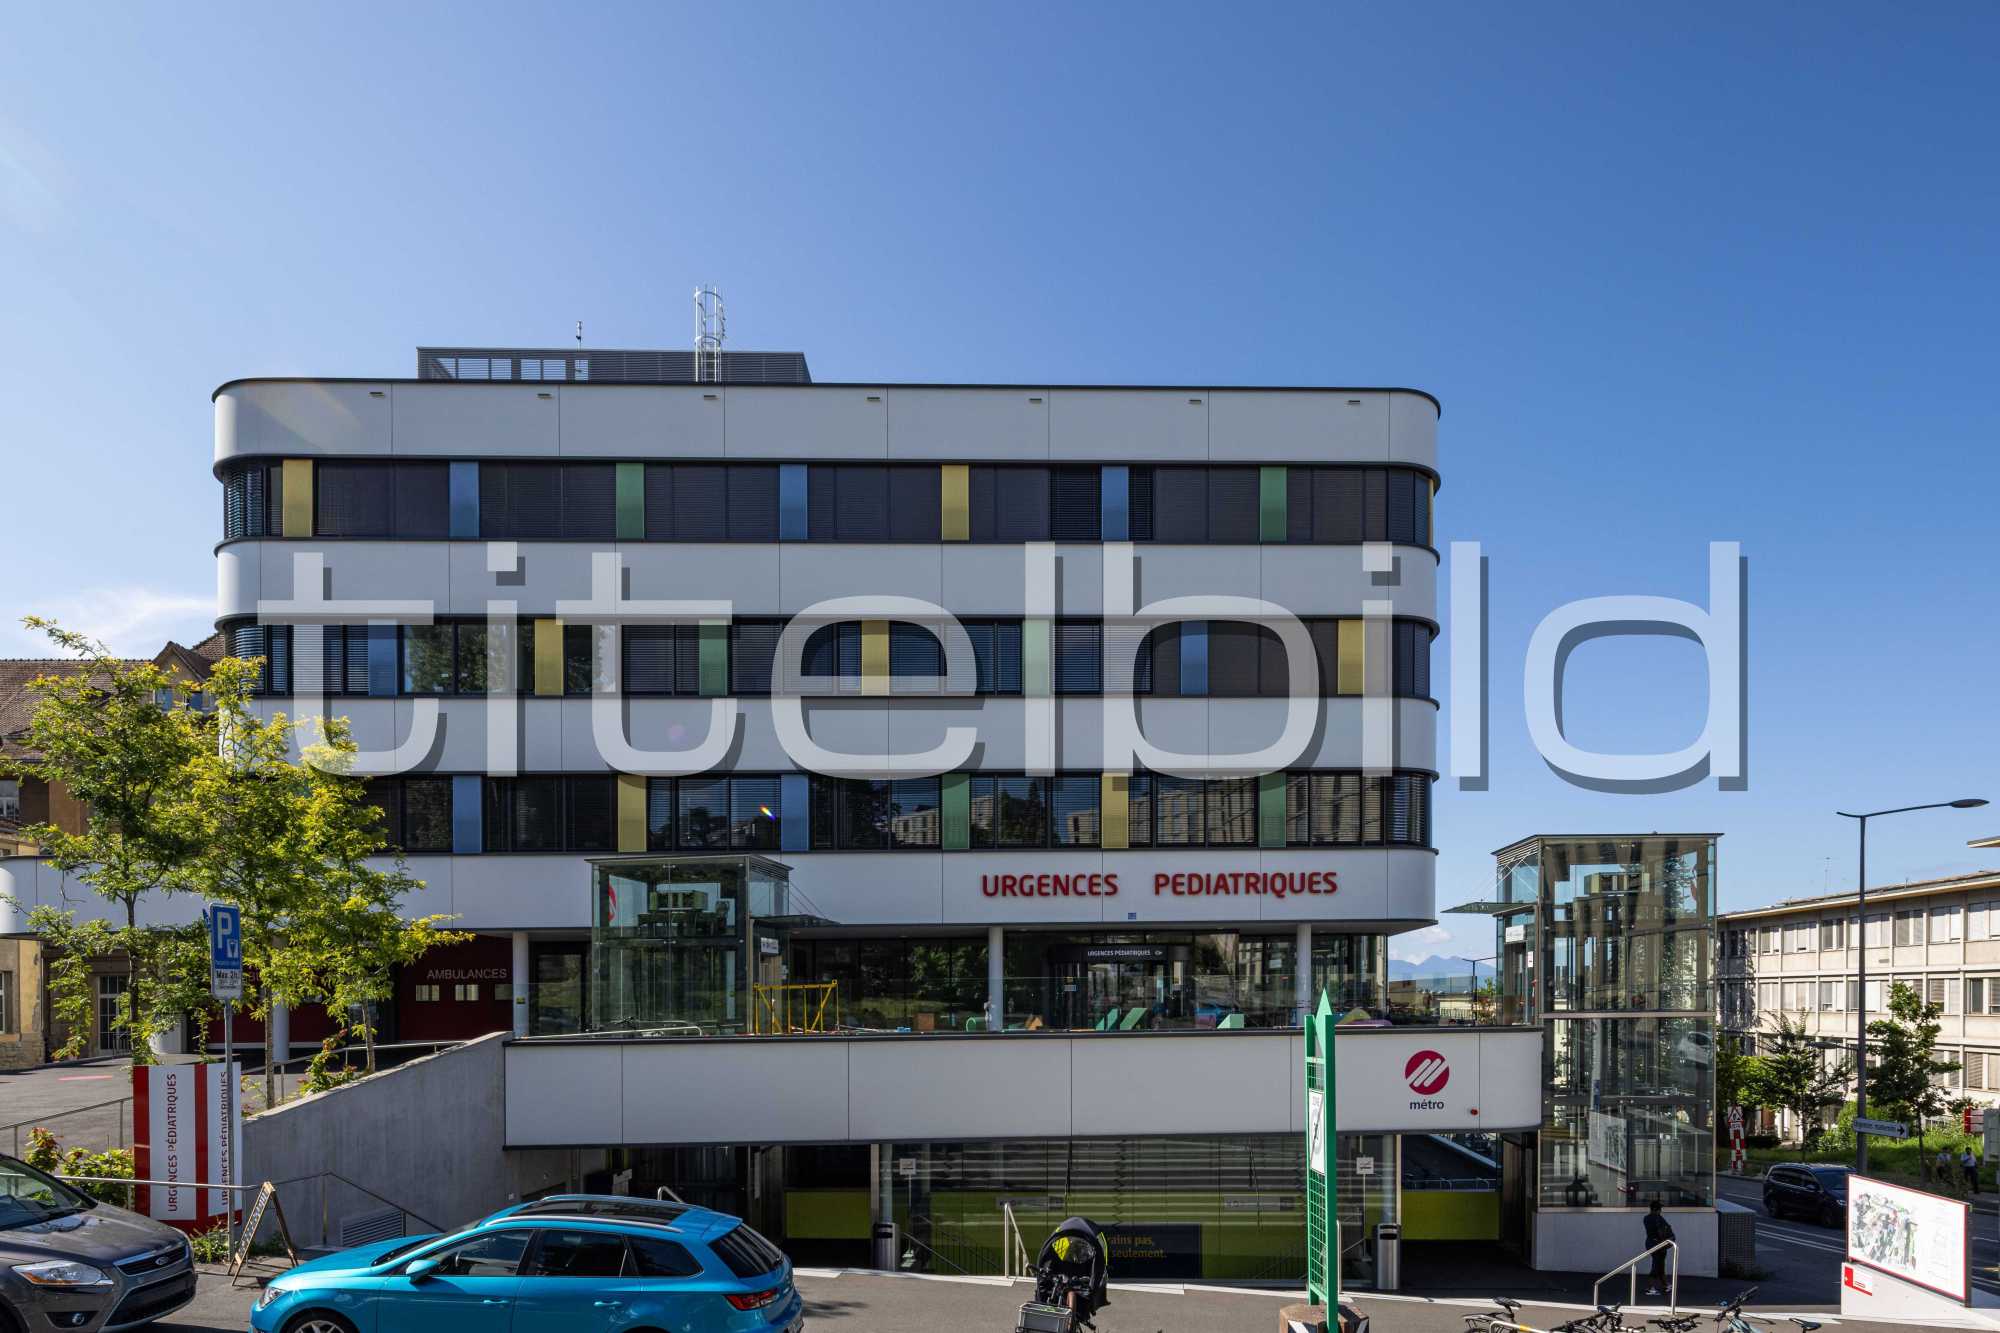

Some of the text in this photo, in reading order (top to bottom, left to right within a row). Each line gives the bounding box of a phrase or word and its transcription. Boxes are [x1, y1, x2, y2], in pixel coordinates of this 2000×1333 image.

[981, 871, 1339, 898] URGENCES PEDIATRIQUES
[217, 911, 232, 949] P
[426, 968, 507, 980] AMBULANCES
[1409, 1098, 1445, 1110] métro
[165, 1073, 178, 1212] URGNCES PÉDIATRIQUES
[1106, 1235, 1132, 1245] rains
